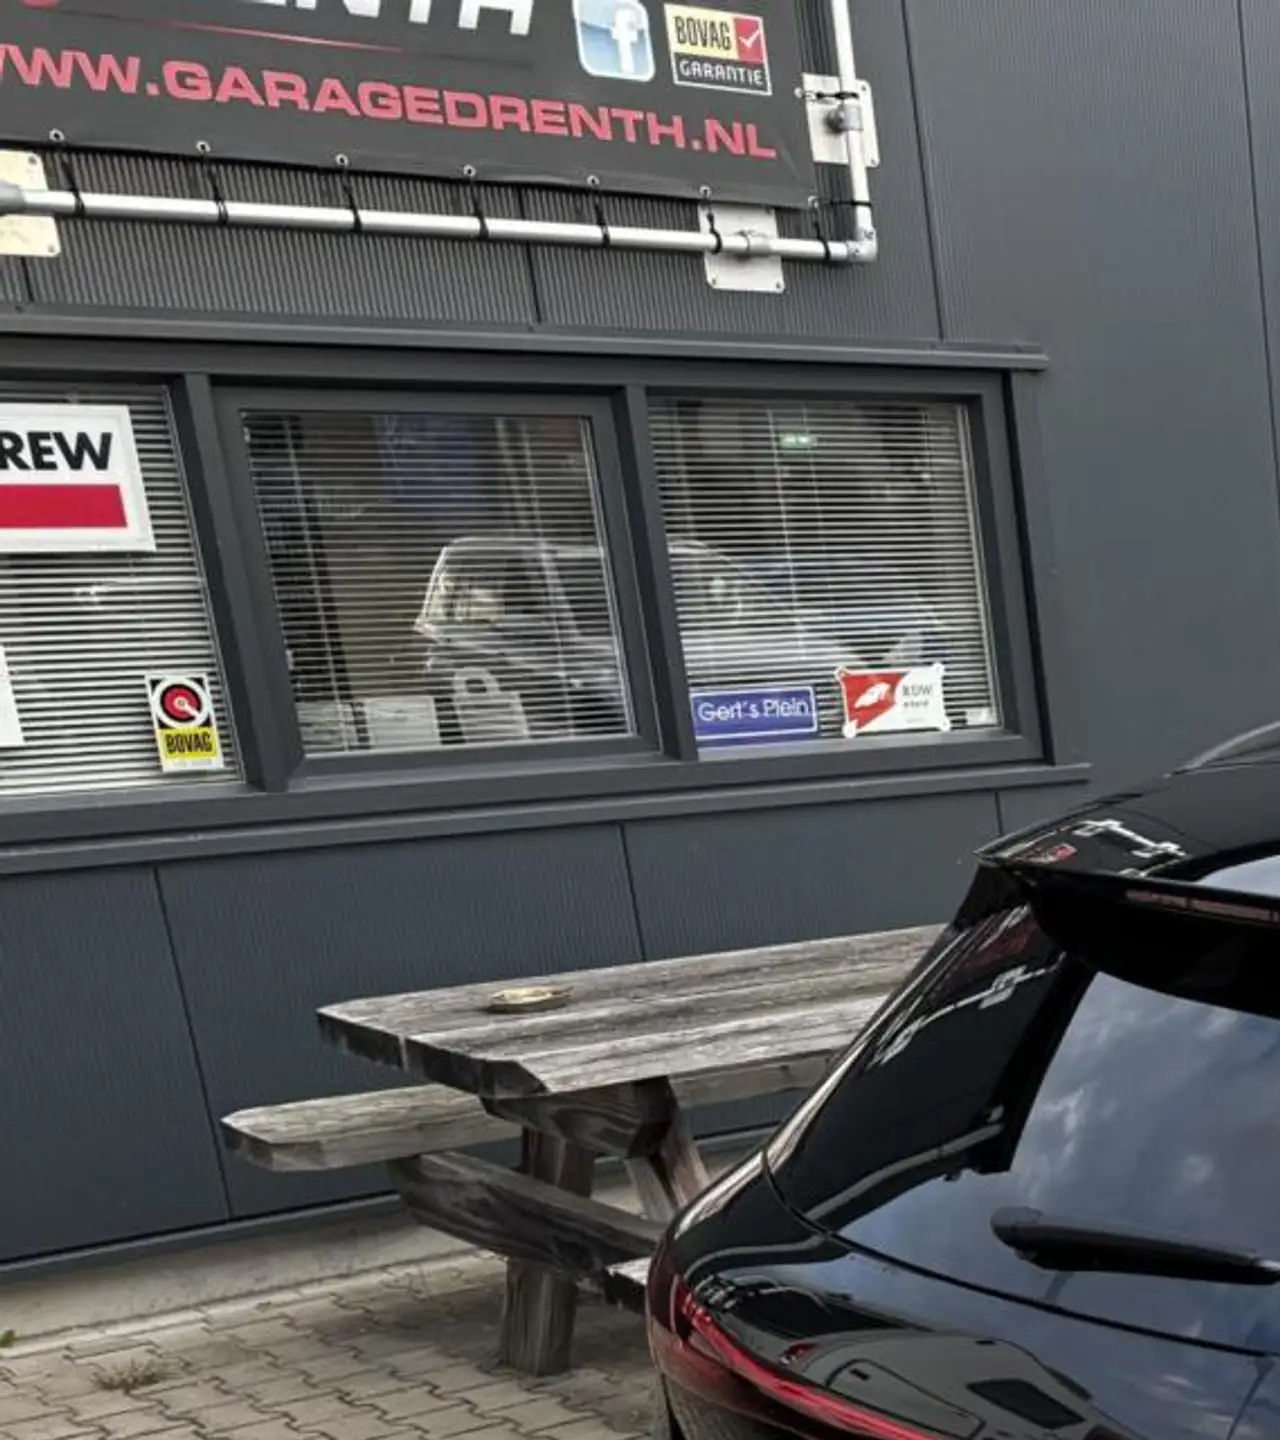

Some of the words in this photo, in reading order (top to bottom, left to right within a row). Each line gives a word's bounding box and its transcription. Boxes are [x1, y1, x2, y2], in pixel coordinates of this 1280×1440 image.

[673, 15, 732, 51] BOVAG
[679, 60, 765, 86] GARANTIE
[0, 43, 777, 159] WW.GARAGEDRENTH.NL
[0, 429, 113, 471] REW
[763, 697, 809, 718] Plein
[165, 731, 213, 755] BOVAG
